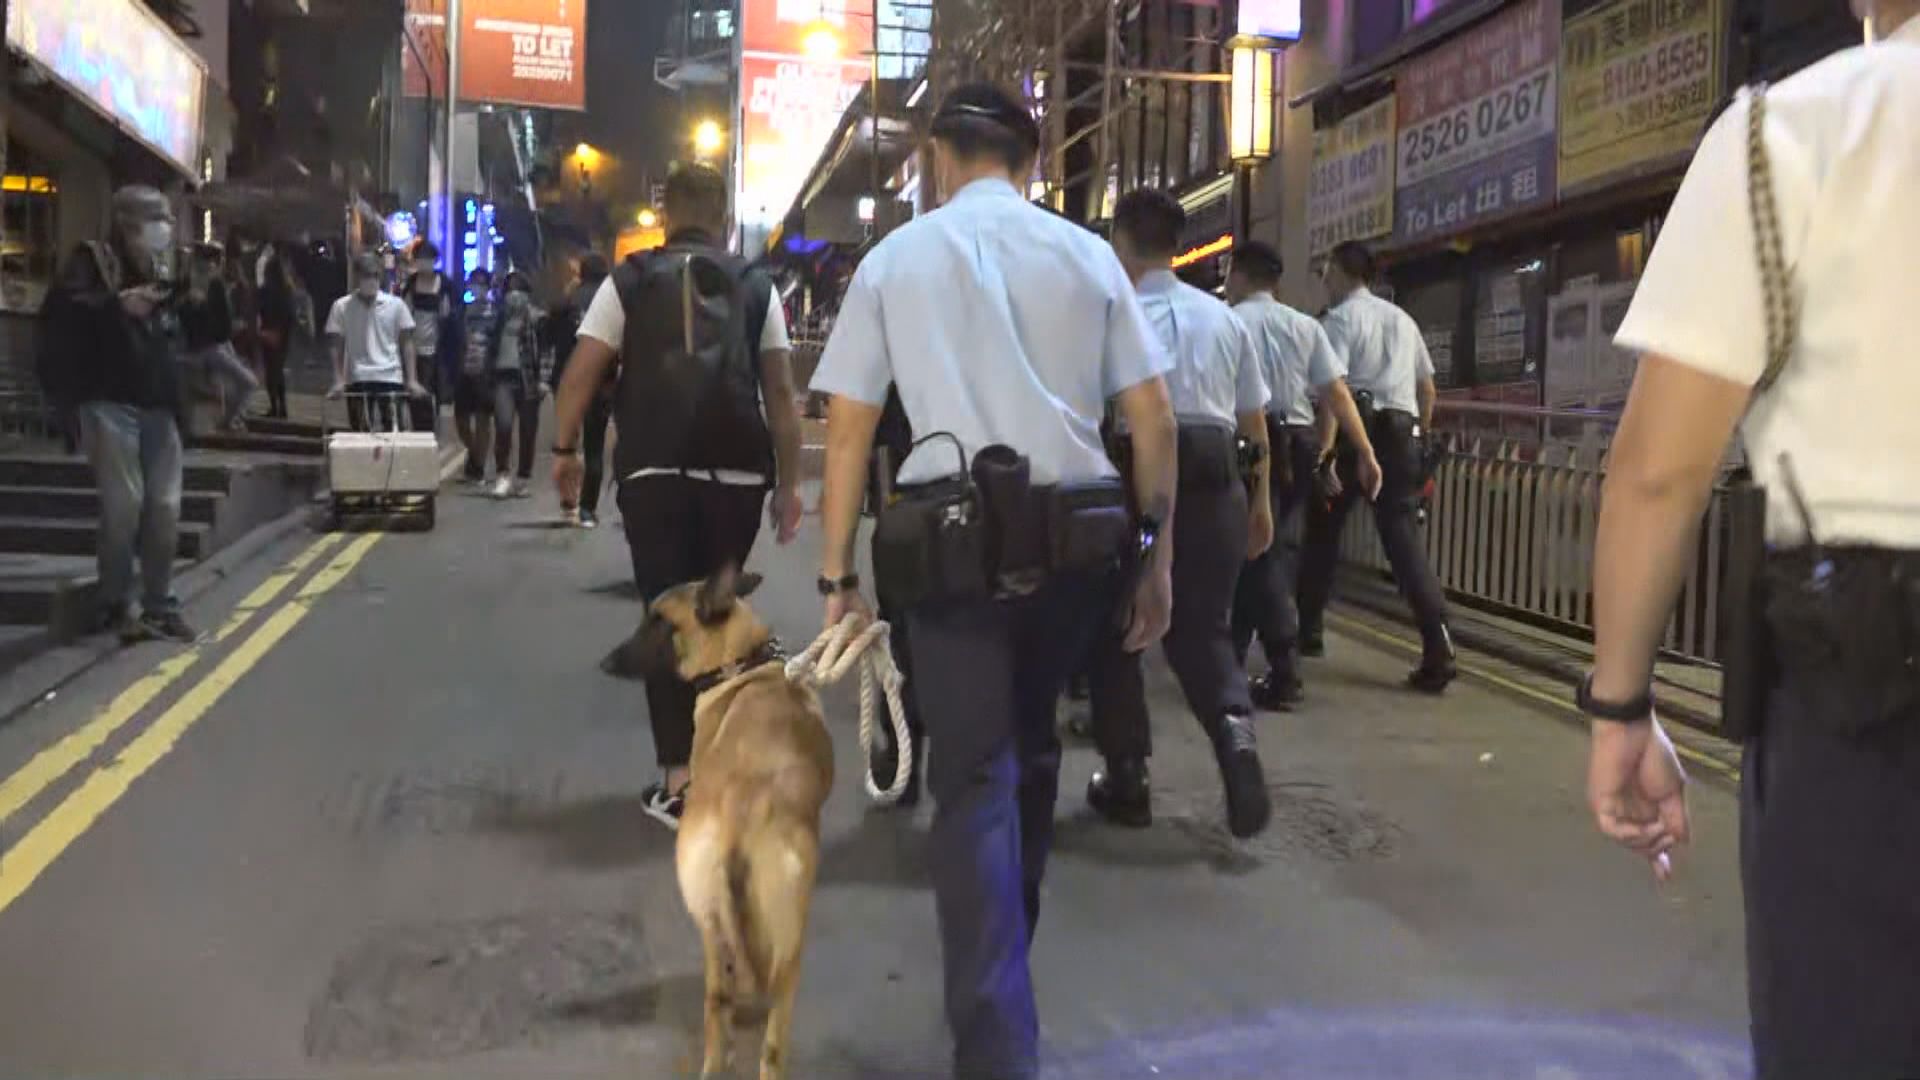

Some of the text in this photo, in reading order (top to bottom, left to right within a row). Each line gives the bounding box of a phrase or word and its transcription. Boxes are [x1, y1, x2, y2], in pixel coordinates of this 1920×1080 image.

[512, 34, 573, 59] TO LET
[1405, 108, 1469, 168] 2526
[1476, 72, 1550, 138] 0267
[1405, 163, 1538, 237] To Let 出租
